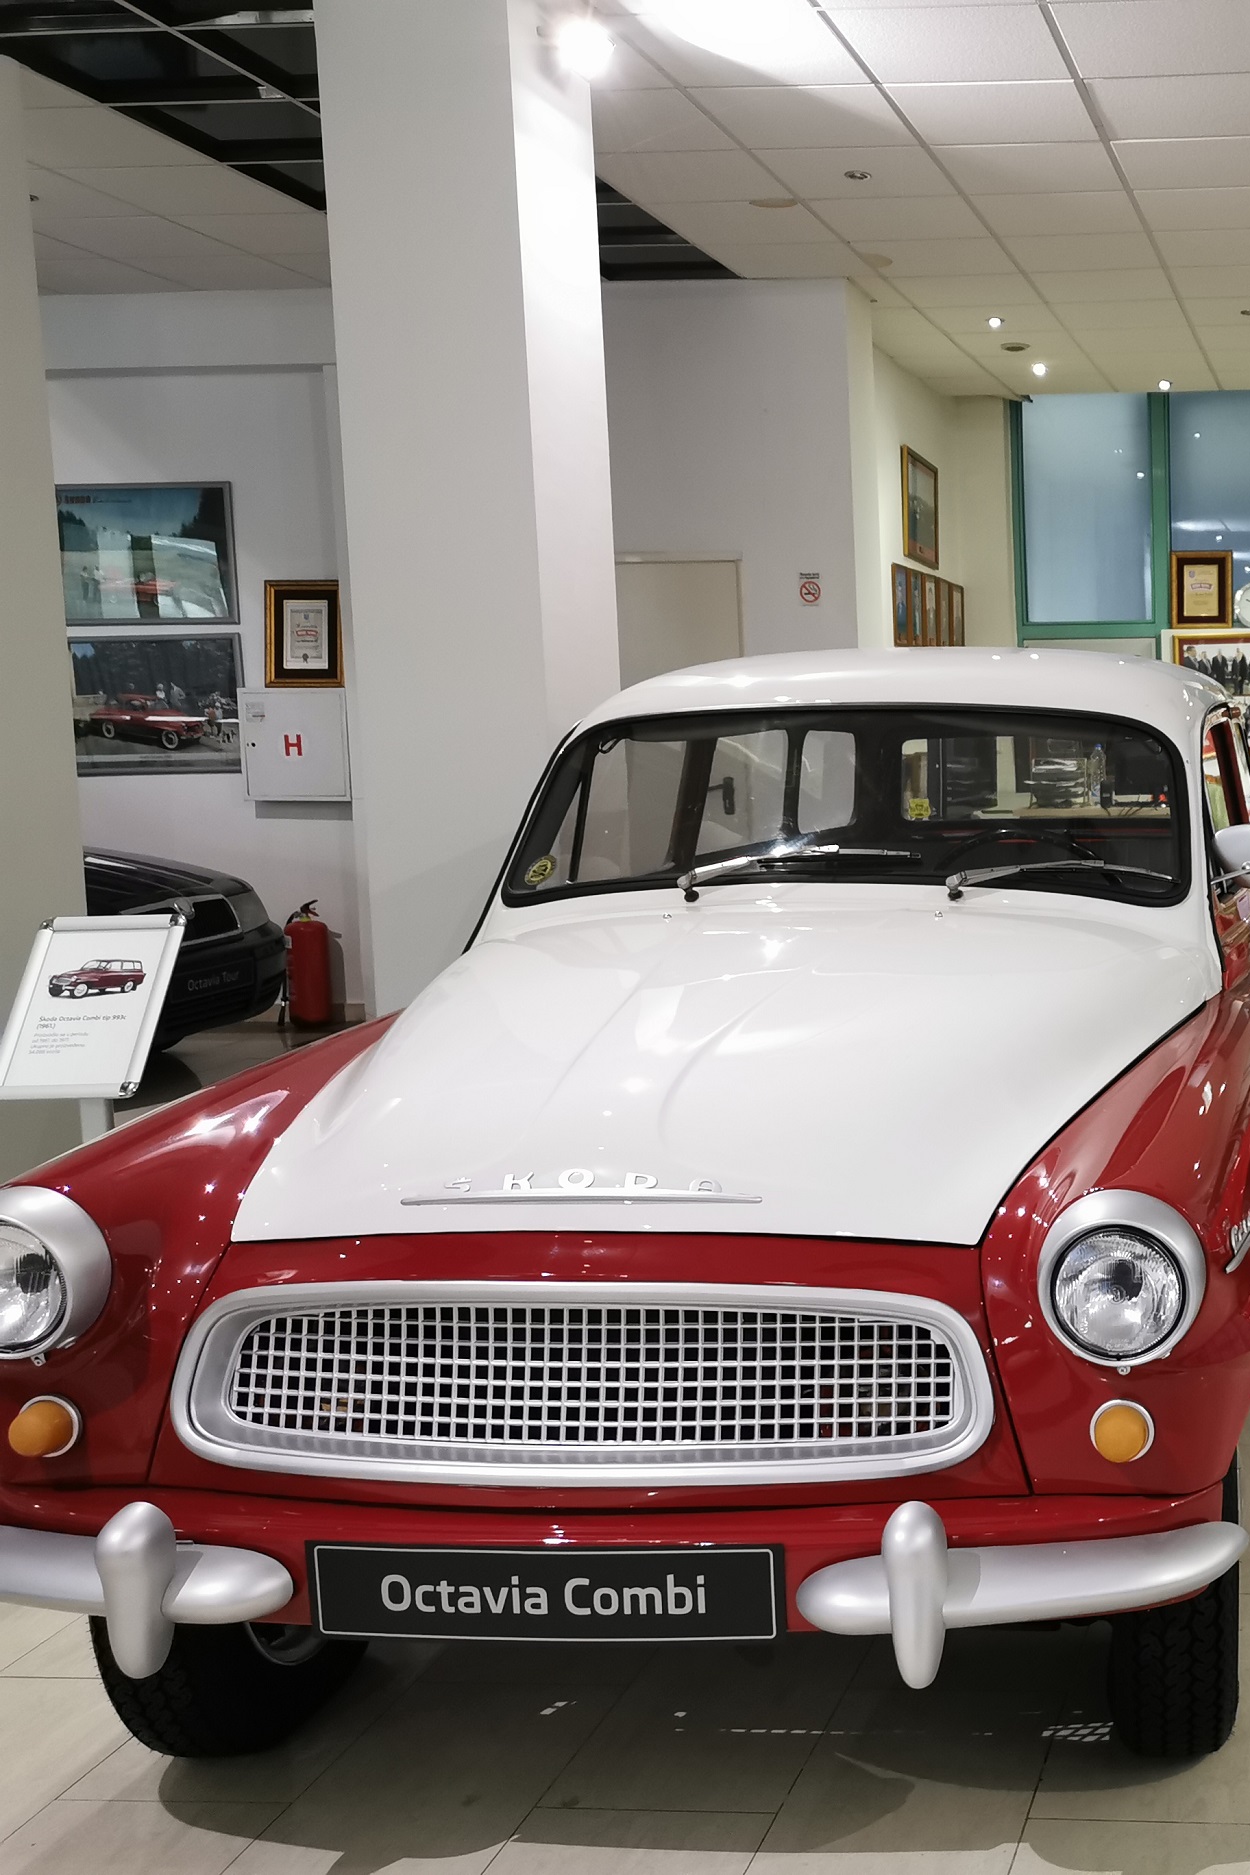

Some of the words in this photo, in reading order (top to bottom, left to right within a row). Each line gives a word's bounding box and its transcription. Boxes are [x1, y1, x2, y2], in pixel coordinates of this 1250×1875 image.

[283, 733, 303, 757] H
[187, 975, 220, 991] Octavia
[222, 970, 239, 983] Tour
[380, 1573, 549, 1616] Octavia
[563, 1573, 708, 1616] Combi
